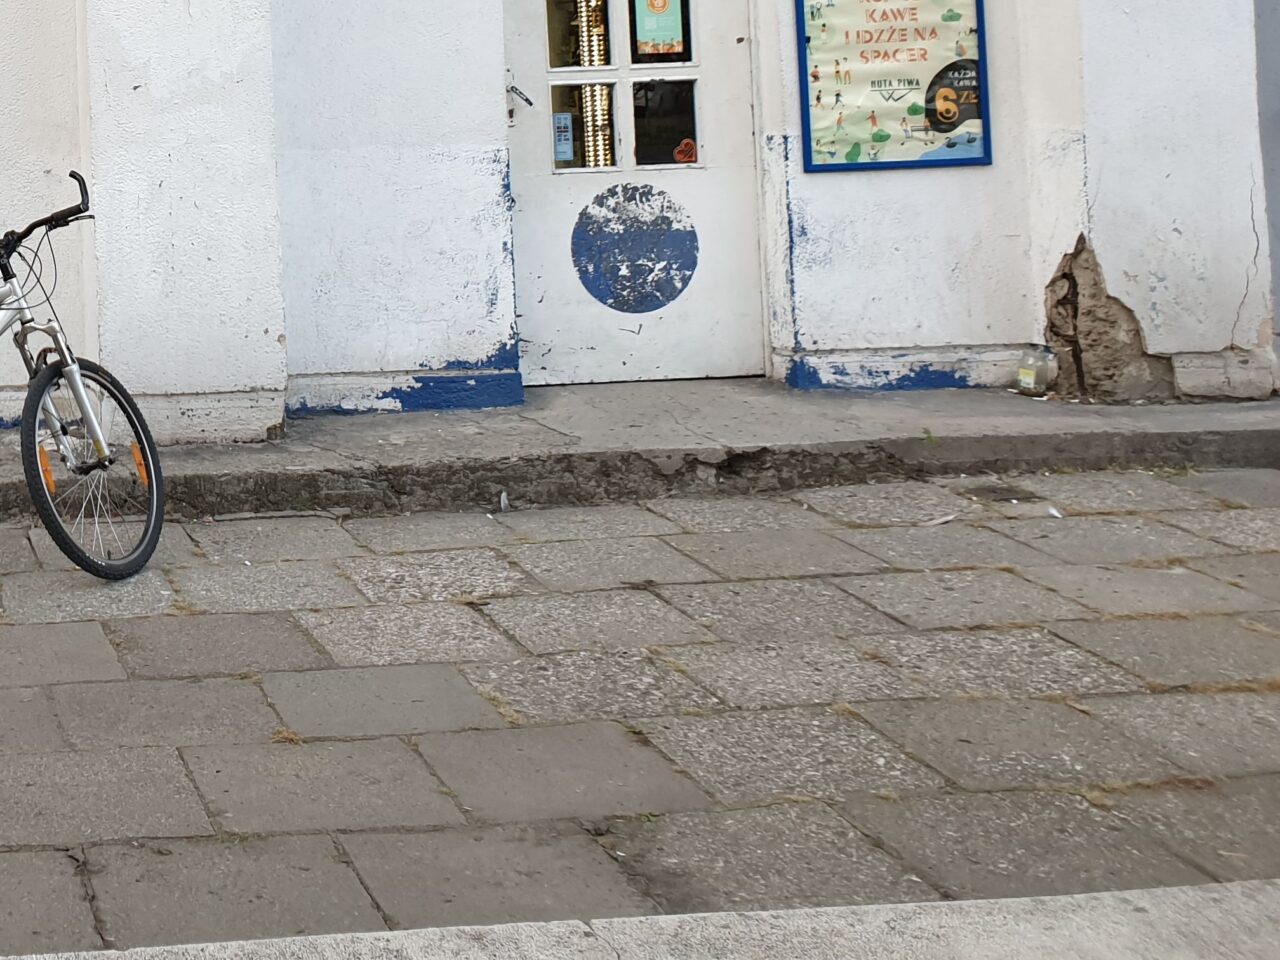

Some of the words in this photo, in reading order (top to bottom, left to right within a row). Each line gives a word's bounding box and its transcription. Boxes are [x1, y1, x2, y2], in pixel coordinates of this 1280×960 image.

[914, 26, 939, 41] NA
[859, 47, 928, 64] SPACER
[870, 79, 893, 88] HUTA
[897, 78, 920, 88] PIWA
[935, 87, 959, 123] 6
